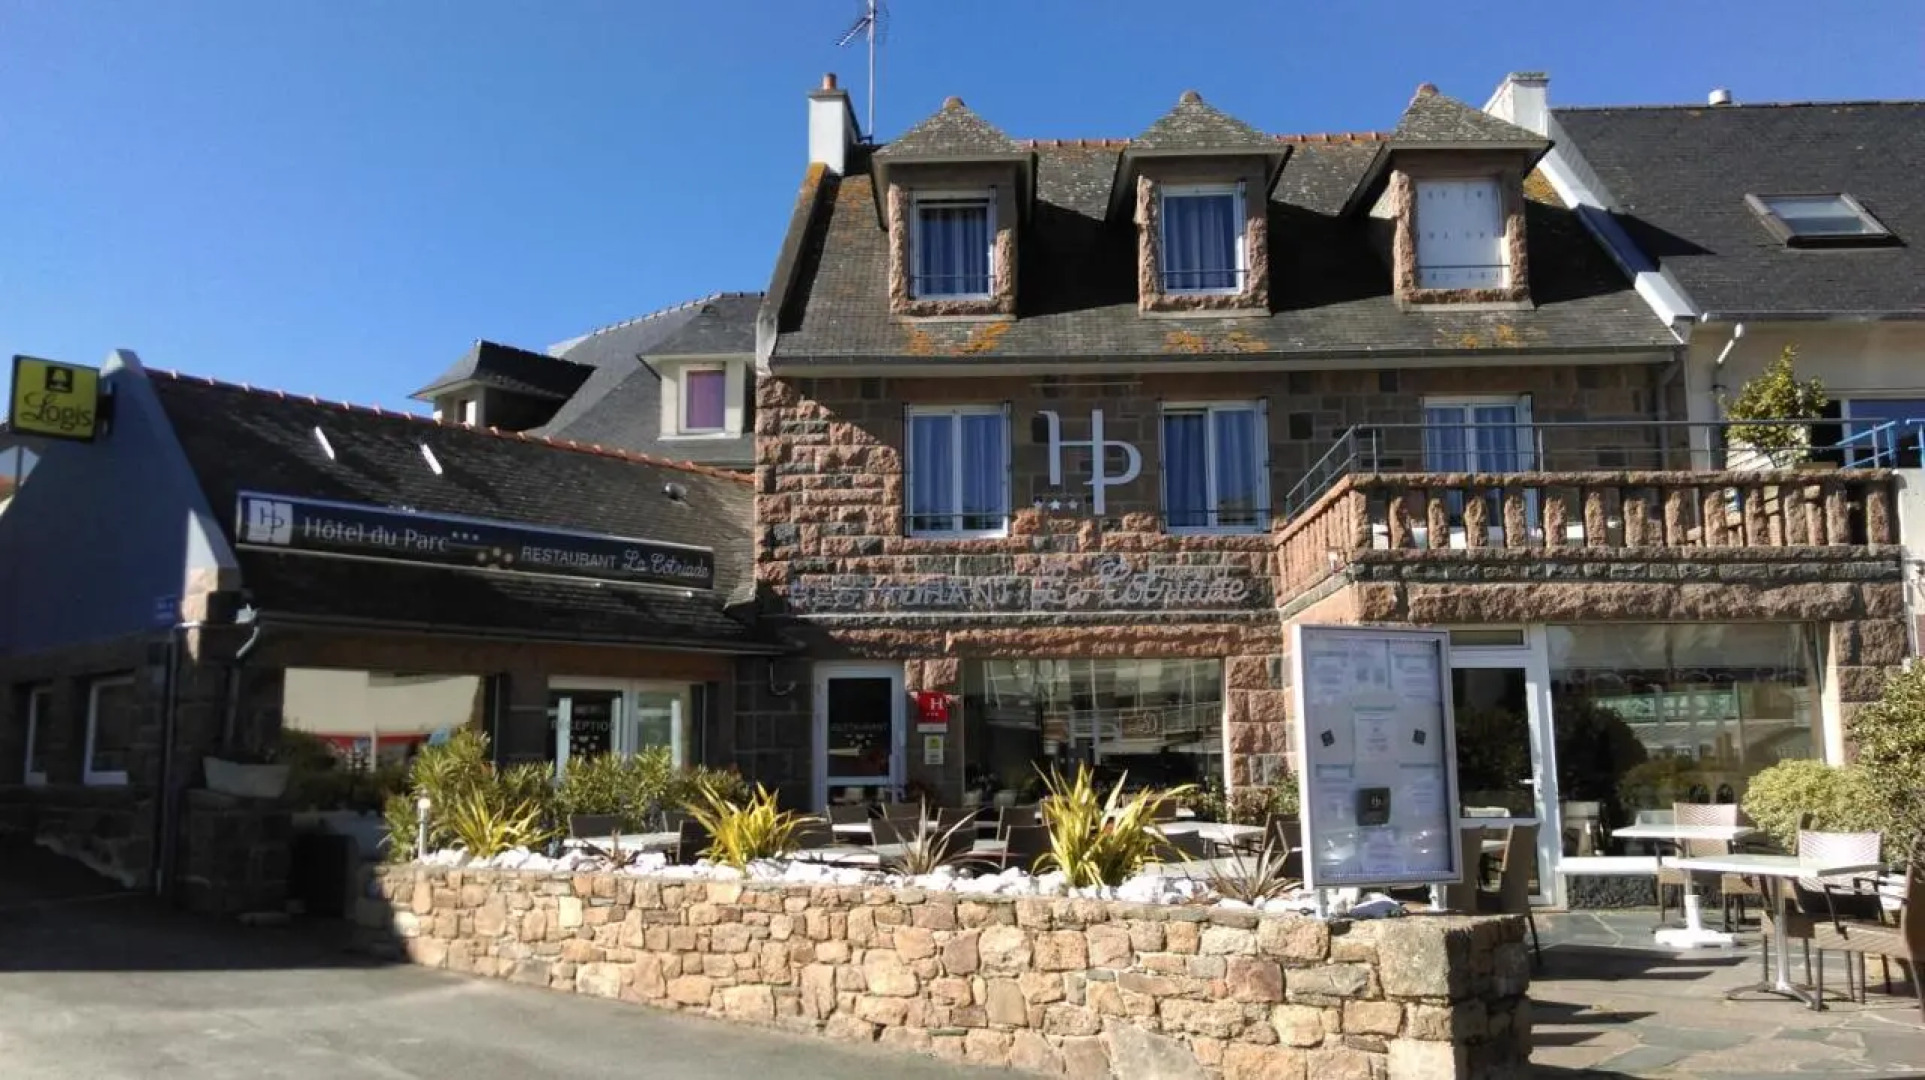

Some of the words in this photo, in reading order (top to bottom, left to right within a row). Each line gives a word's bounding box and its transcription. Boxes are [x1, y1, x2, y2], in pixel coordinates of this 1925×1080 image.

[20, 391, 92, 431] Logis
[1036, 408, 1142, 515] HP
[304, 516, 364, 543] Hôtel
[371, 524, 397, 547] du
[404, 527, 449, 554] Parc
[521, 545, 617, 570] RESTAURANT
[623, 548, 648, 573] La
[650, 552, 710, 579] Cotriade
[789, 577, 1018, 608] RESTAURANT
[1098, 556, 1249, 606] Cotriade
[930, 697, 944, 711] H
